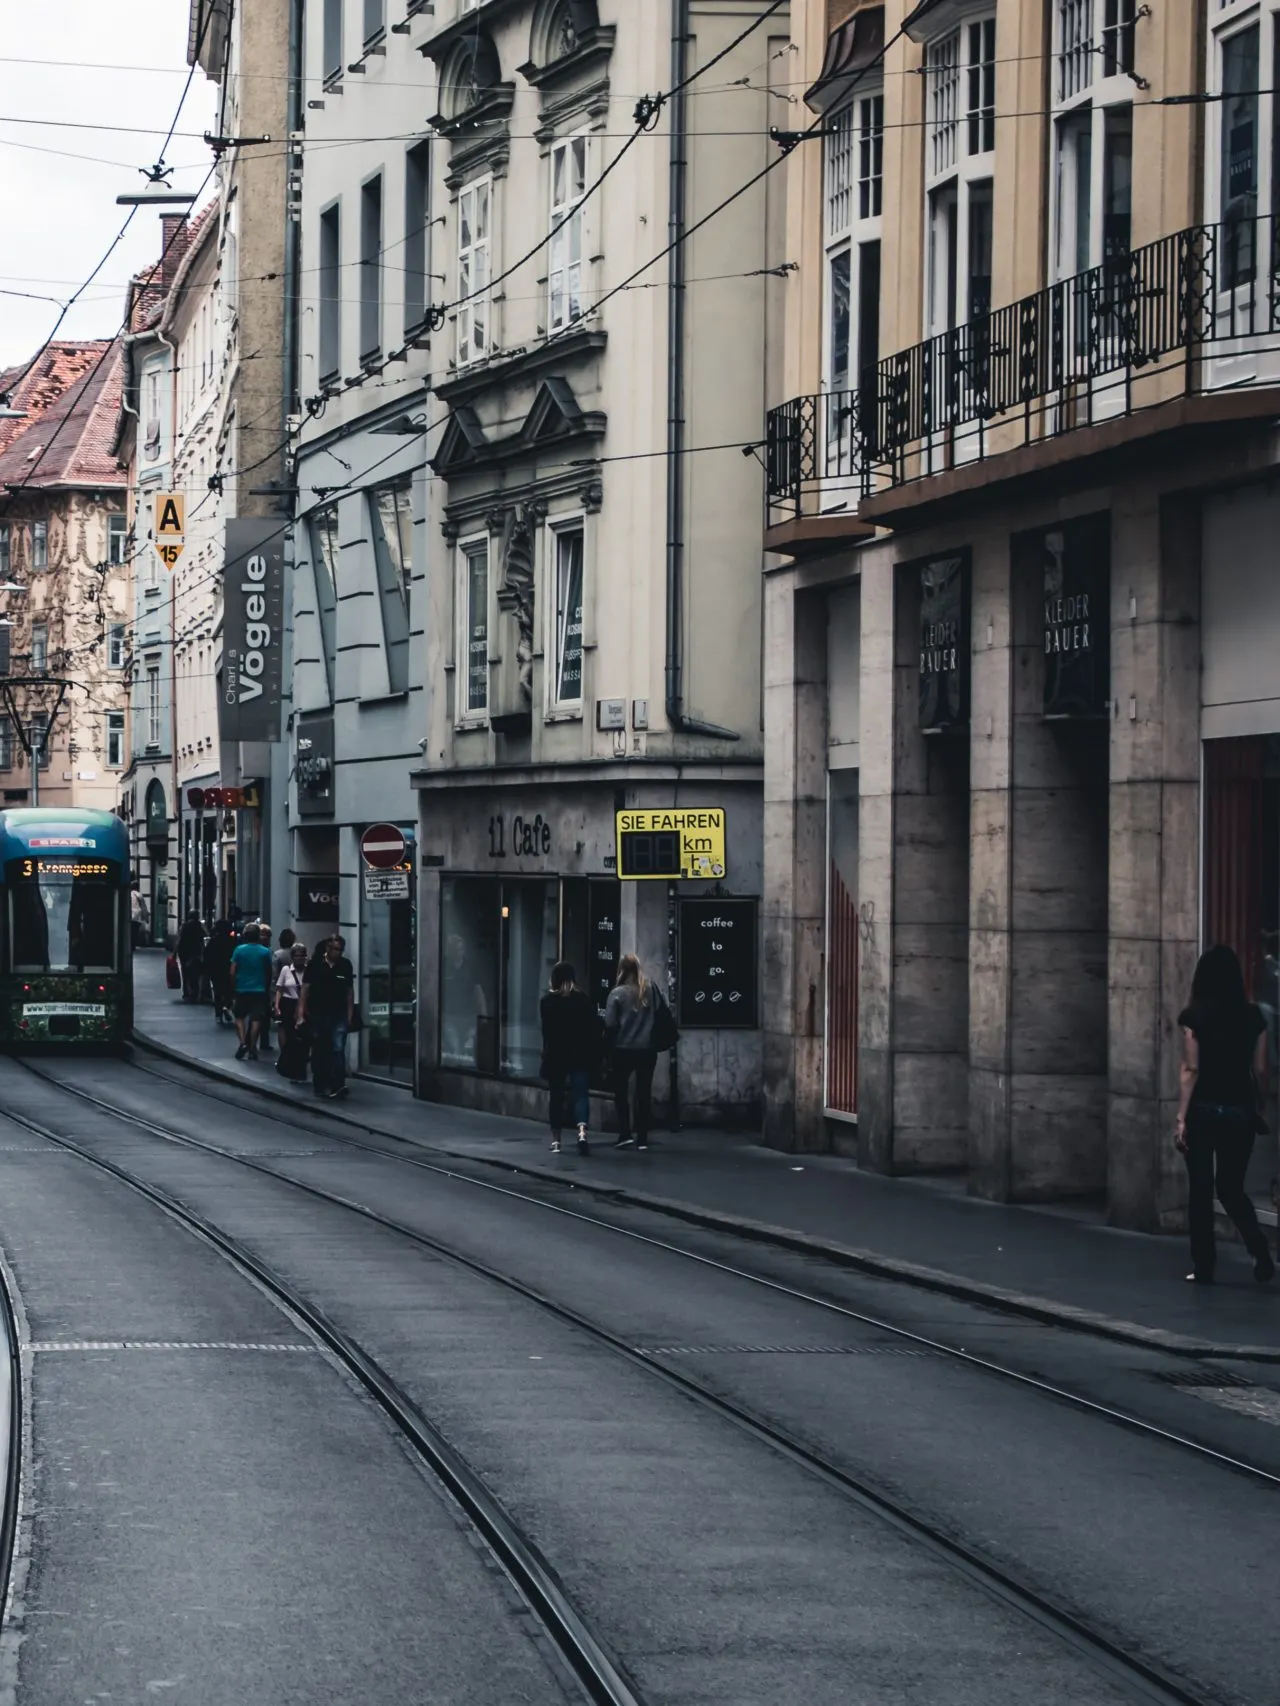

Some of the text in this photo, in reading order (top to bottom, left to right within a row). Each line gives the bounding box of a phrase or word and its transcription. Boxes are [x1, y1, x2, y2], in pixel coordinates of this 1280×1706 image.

[160, 499, 181, 531] A
[160, 545, 178, 563] 15
[1045, 593, 1089, 624] KLEIDER
[238, 555, 271, 704] Vögele
[1045, 624, 1089, 654] BAUER
[920, 648, 956, 674] BAUER
[621, 813, 720, 830] SIE FAHREN
[513, 814, 551, 856] Cafe
[683, 835, 712, 850] km
[23, 860, 33, 876] 3
[701, 917, 734, 928] coffee
[711, 941, 723, 951] to
